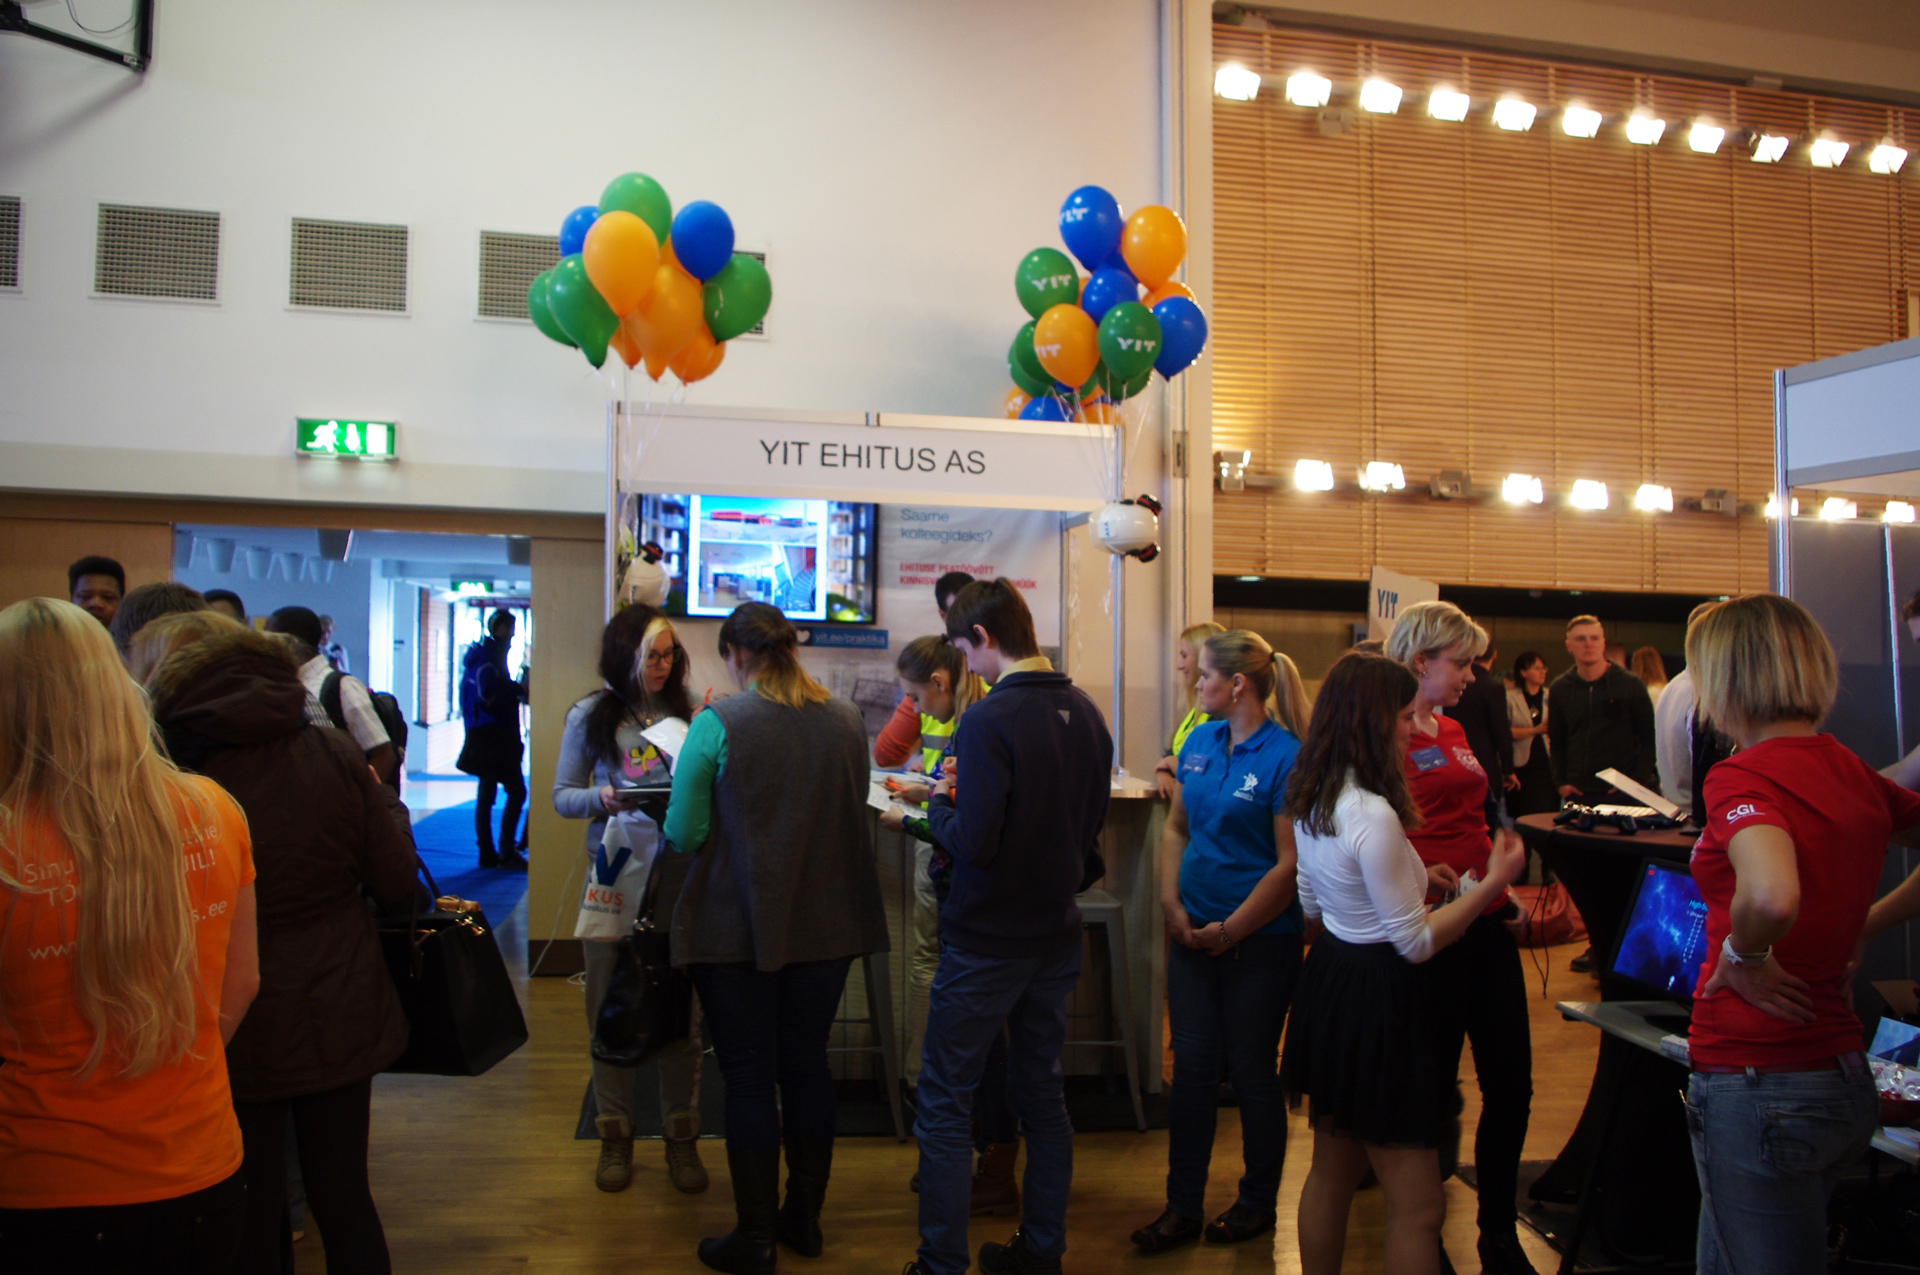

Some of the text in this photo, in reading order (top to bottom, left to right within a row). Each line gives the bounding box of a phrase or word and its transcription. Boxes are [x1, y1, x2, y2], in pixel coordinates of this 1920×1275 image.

[1032, 274, 1072, 291] YIT
[1117, 337, 1156, 352] YIT
[759, 439, 986, 475] YIT EHITUS AS
[900, 508, 950, 523] Saame
[900, 527, 993, 545] kolleegideks?
[899, 562, 936, 573] EHITUSE
[1726, 803, 1755, 821] CGI
